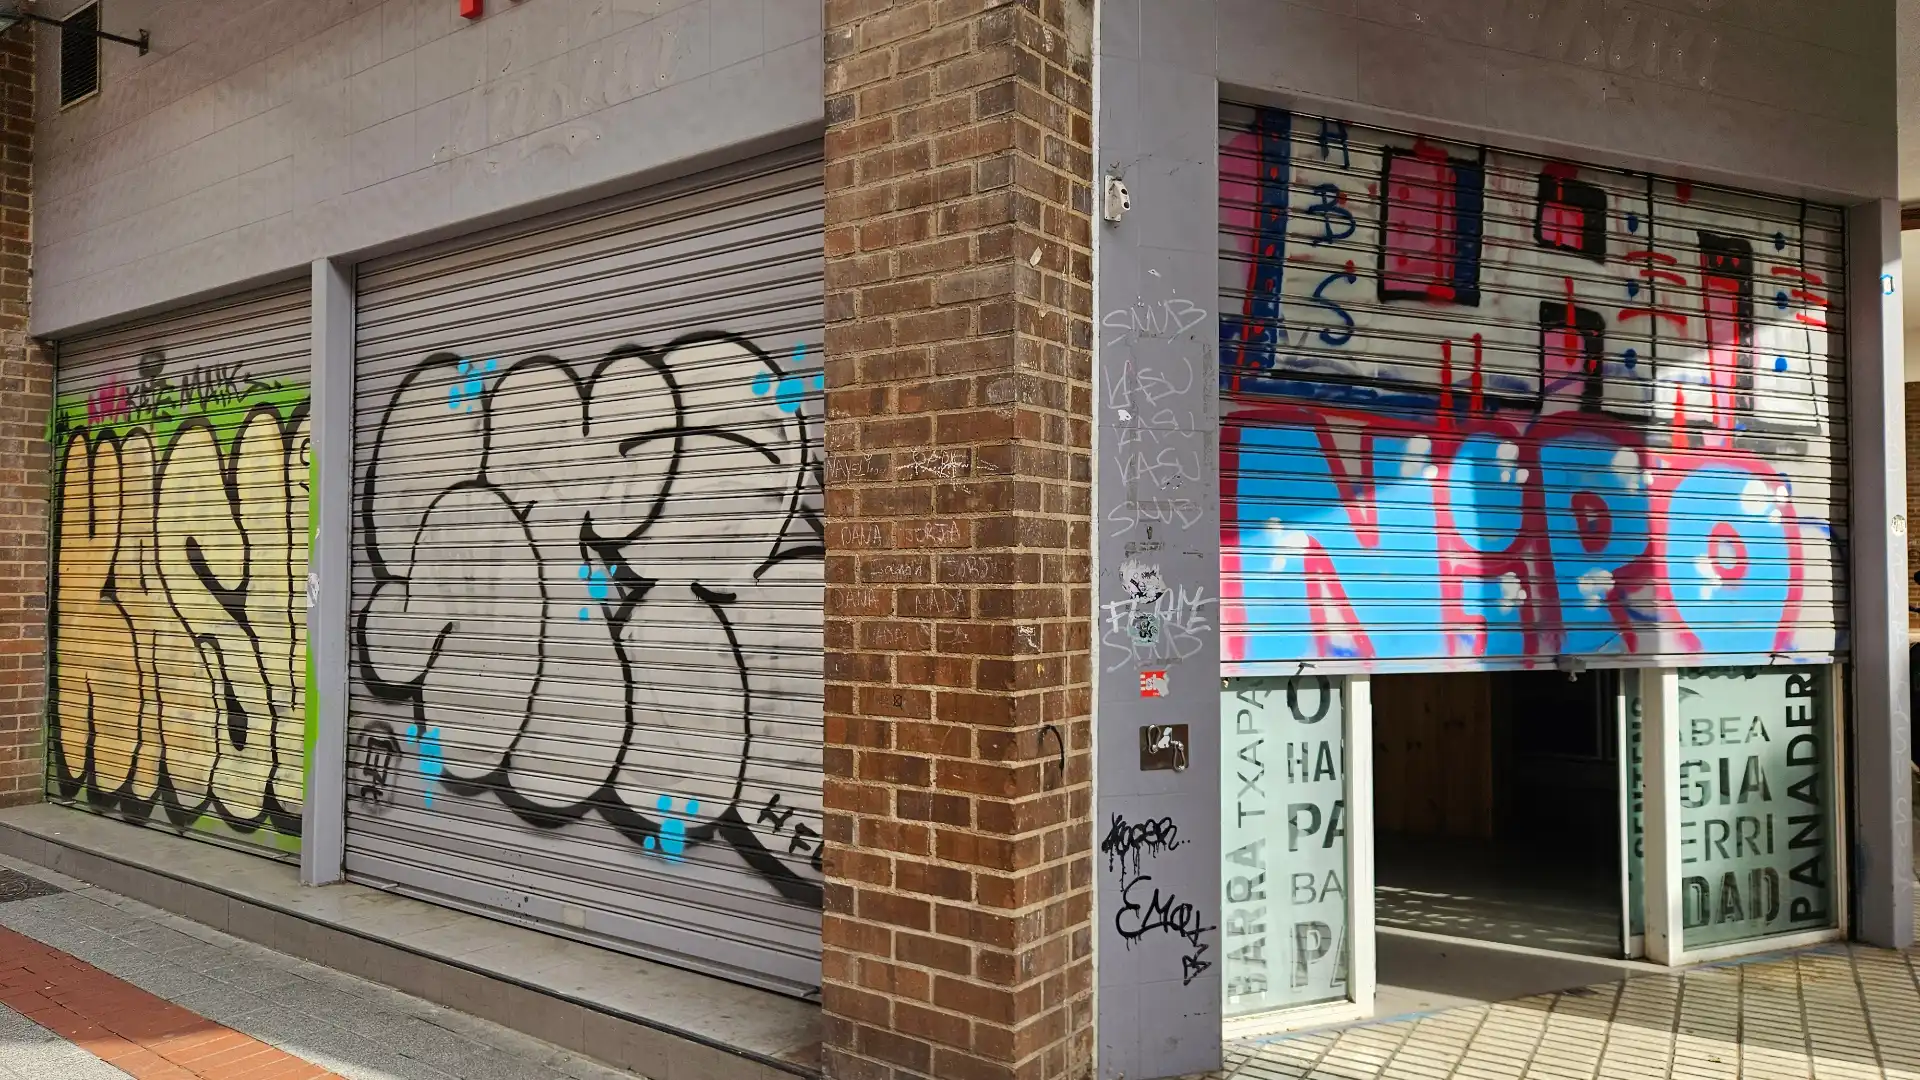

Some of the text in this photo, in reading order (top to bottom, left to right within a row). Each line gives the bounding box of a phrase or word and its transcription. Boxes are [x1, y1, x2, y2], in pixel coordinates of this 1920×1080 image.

[1679, 715, 1771, 748] BEA
[1286, 740, 1345, 783] HA
[1224, 837, 1268, 1003] BARRA
